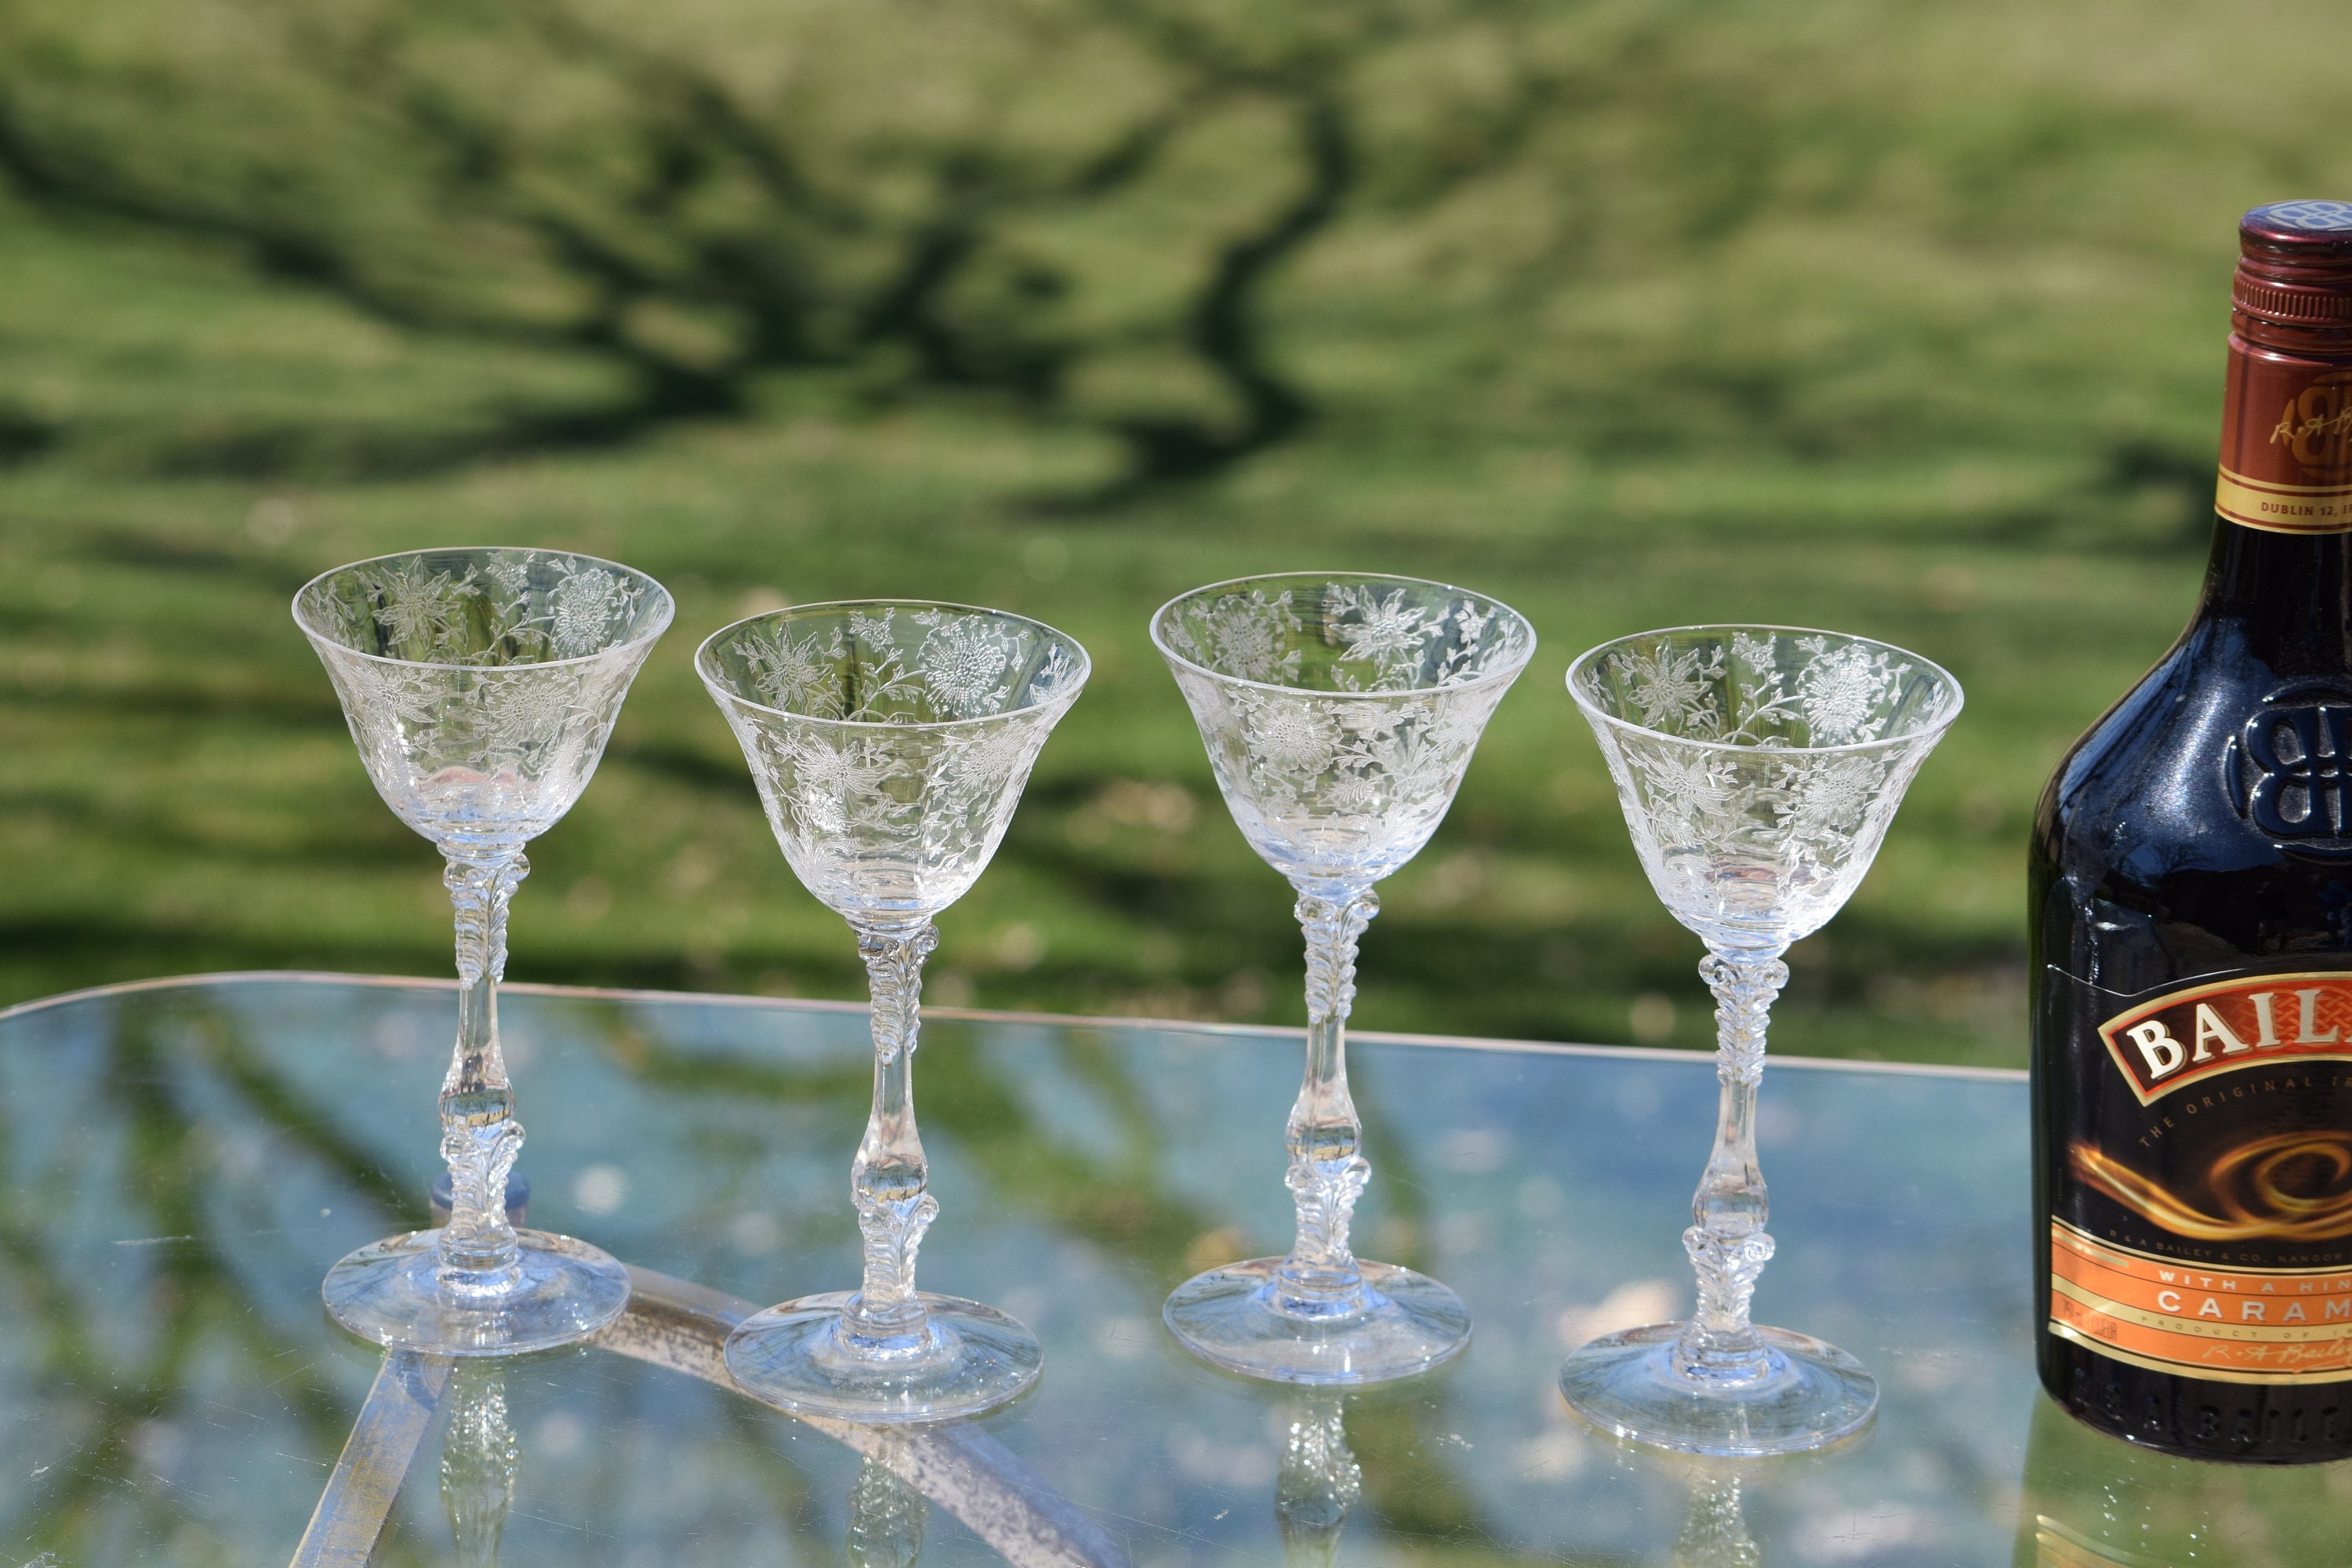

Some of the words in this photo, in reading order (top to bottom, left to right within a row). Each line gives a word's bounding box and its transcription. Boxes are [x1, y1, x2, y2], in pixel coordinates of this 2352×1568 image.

[2261, 502, 2314, 516] DUBLIN
[2321, 506, 2338, 517] 12,
[2126, 988, 2352, 1080] BAIL
[2139, 1116, 2176, 1148] THE
[2185, 1077, 2313, 1115] ORIGINAL
[2109, 1229, 2117, 1238] R
[2155, 1242, 2212, 1258] BAILEY
[2158, 1270, 2236, 1290] WITH
[2260, 1282, 2274, 1292] A
[2157, 1290, 2352, 1323] CARAM
[2141, 1316, 2257, 1338] PRODUCT
[2282, 1330, 2310, 1339] OF
